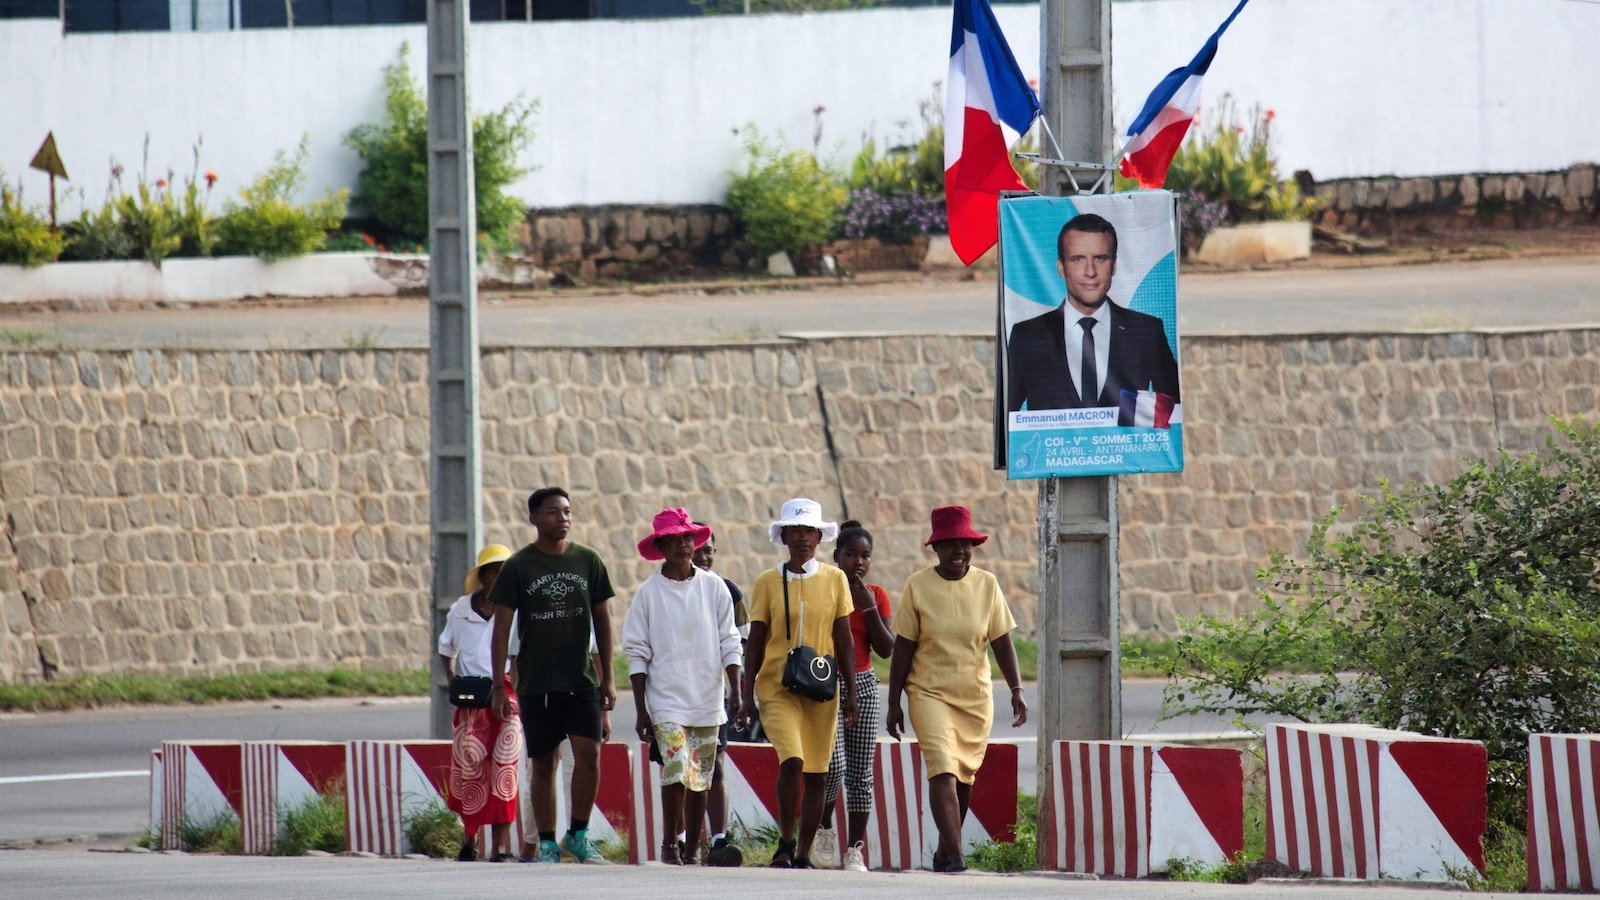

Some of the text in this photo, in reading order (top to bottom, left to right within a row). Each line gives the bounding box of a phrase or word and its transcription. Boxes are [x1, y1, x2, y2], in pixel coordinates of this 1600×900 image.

[1015, 410, 1114, 423] Emmanuel MACRON
[1044, 437, 1063, 447] COI
[1092, 433, 1140, 445] SOMMET
[1142, 432, 1169, 442] 2025
[1045, 448, 1057, 457] 24
[1060, 447, 1085, 456] AVRIL
[1096, 442, 1170, 454] ANTANANARIVO
[1046, 455, 1123, 467] MADAGASCAR
[526, 573, 588, 596] HEARTLANDERS
[530, 611, 554, 620] HIGH
